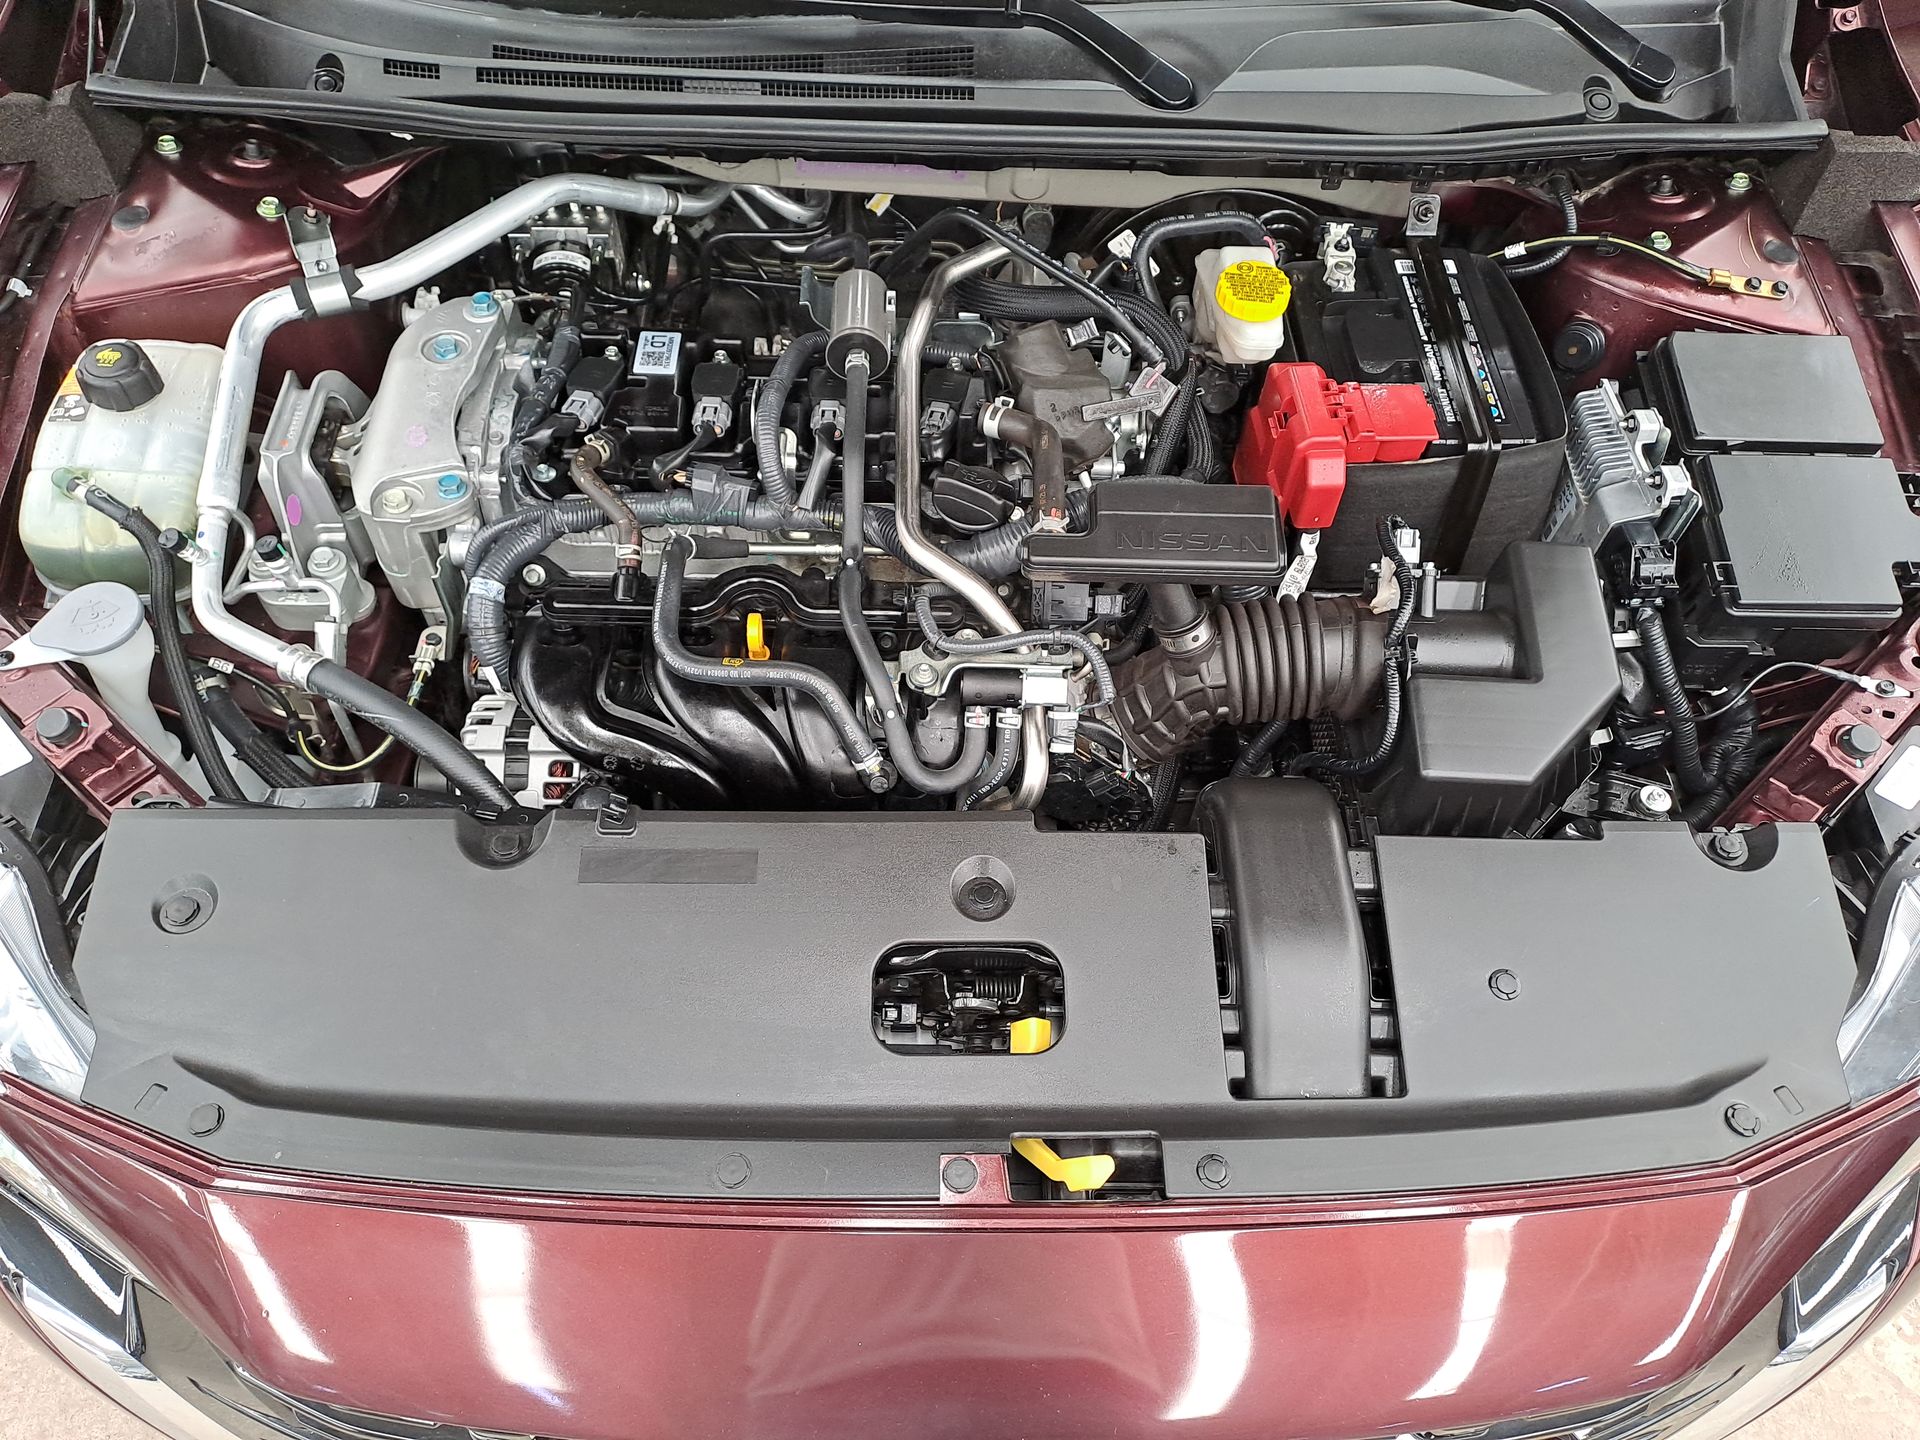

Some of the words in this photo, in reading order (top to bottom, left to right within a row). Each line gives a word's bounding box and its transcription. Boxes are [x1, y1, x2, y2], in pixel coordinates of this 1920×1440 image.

[651, 335, 667, 348] LD
[1423, 343, 1442, 381] NISSAN
[1436, 387, 1456, 423] RENAULT
[1116, 530, 1269, 553] NISSAN
[211, 659, 230, 672] B6
[739, 669, 751, 677] DOT
[829, 701, 840, 713] DOT
